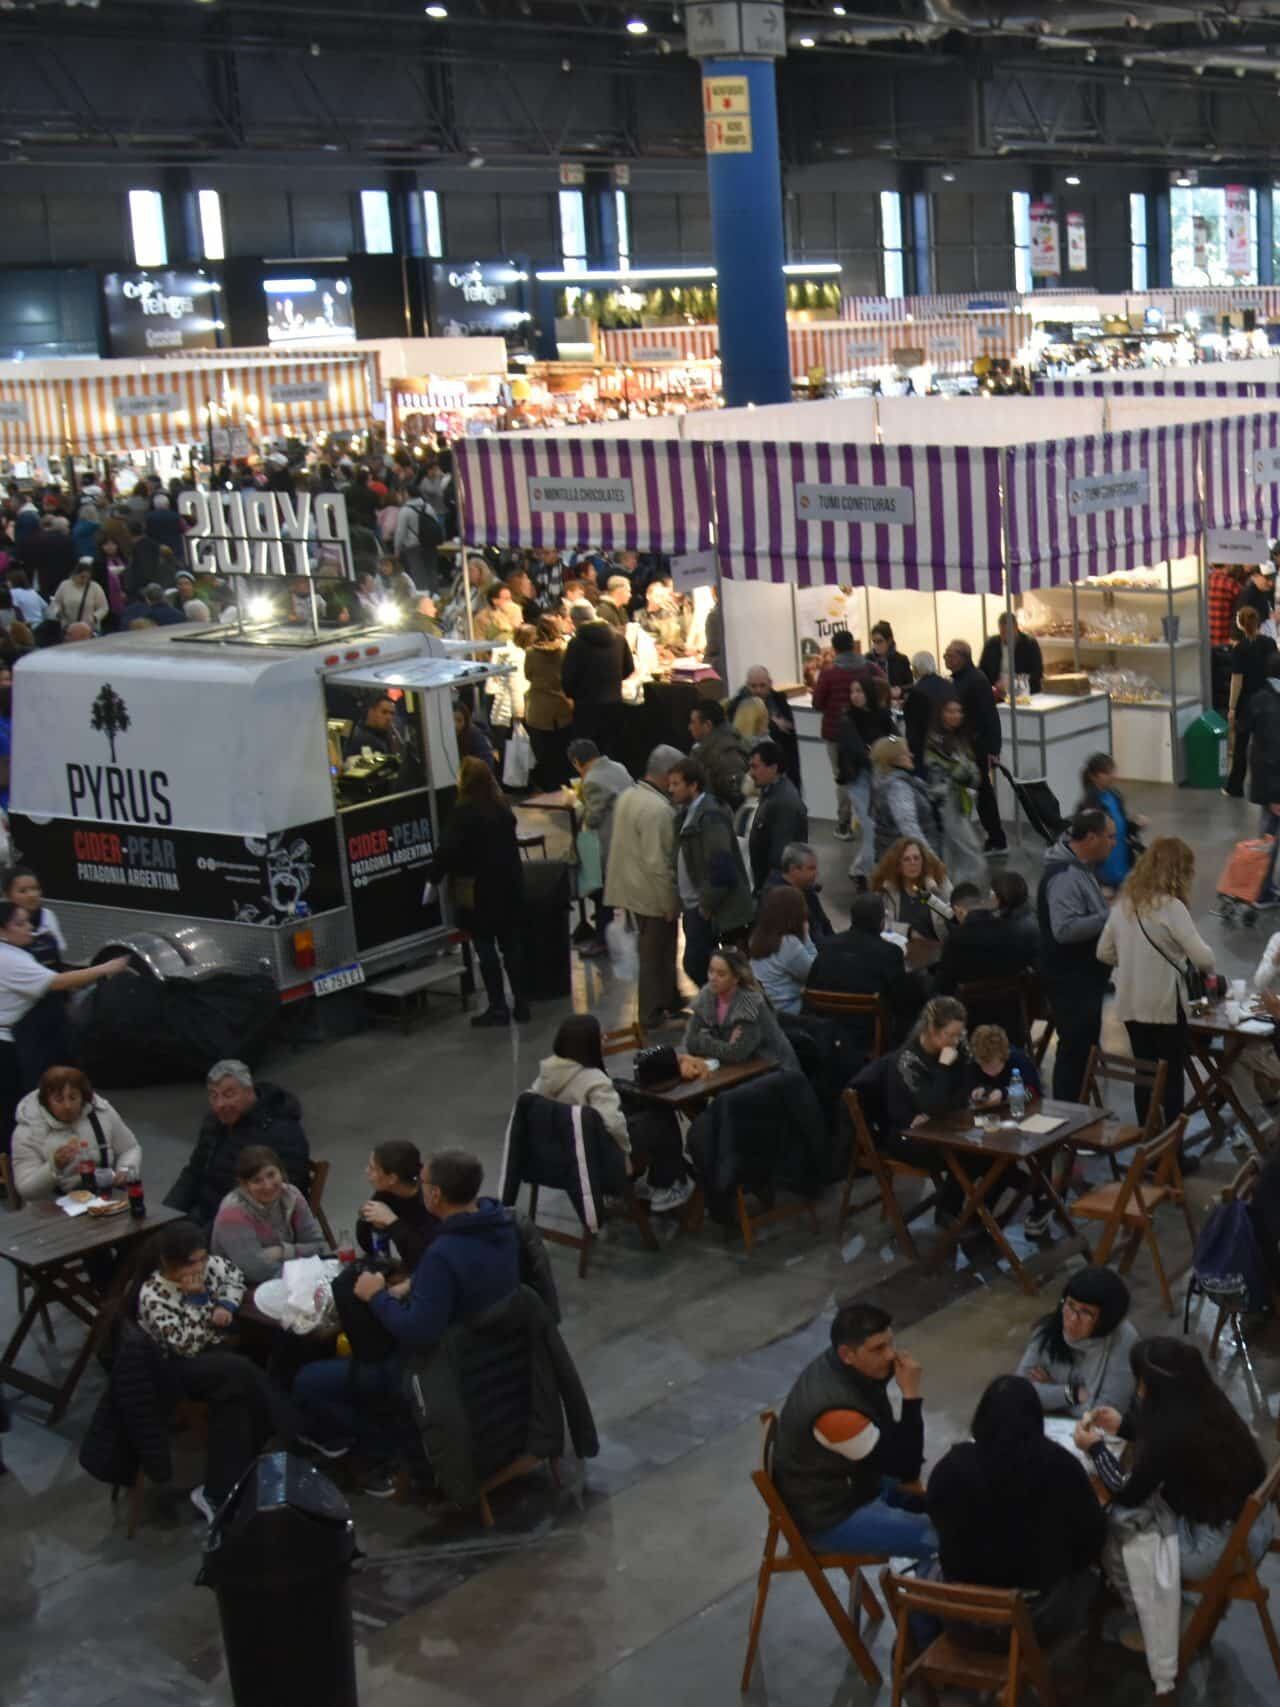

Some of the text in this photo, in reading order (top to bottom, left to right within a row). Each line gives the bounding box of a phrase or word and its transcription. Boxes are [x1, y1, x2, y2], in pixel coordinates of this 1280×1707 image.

[578, 487, 625, 502] CHOCOLATES
[817, 494, 897, 512] TUMI CONFITURAS
[66, 763, 173, 826] PYRUS
[351, 853, 392, 878] PATAGONIA
[393, 842, 433, 865] ARGENTINA
[77, 862, 180, 891] PATAGONIA ARGENTINA
